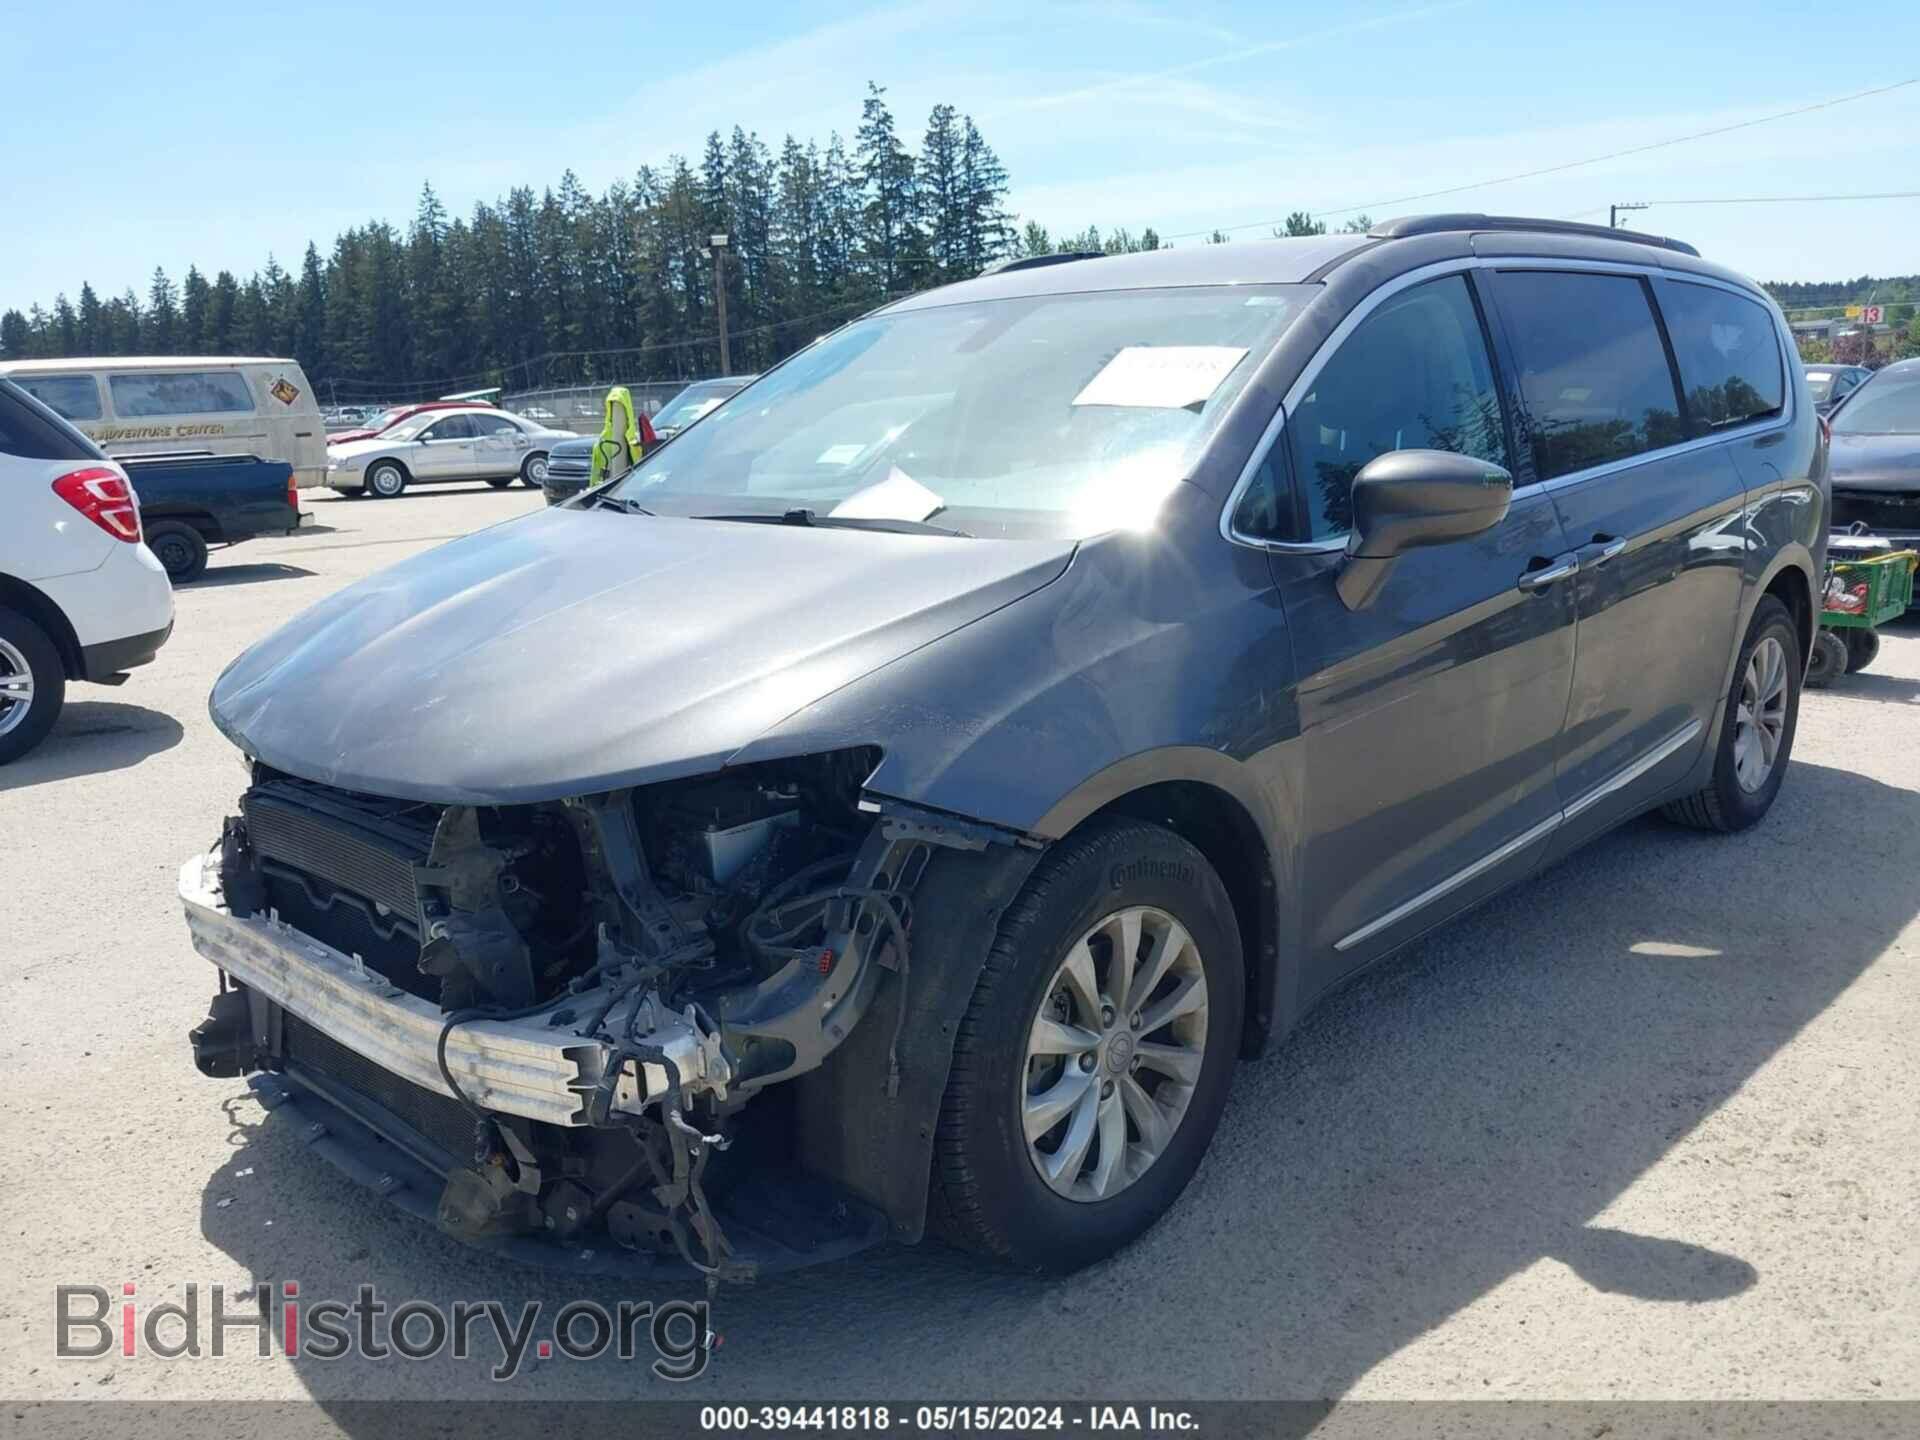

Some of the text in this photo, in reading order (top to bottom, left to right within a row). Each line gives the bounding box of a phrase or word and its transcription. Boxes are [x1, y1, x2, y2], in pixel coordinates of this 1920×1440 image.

[1863, 307, 1879, 322] 13
[175, 423, 225, 437] CENTER
[1110, 857, 1195, 890] Continental
